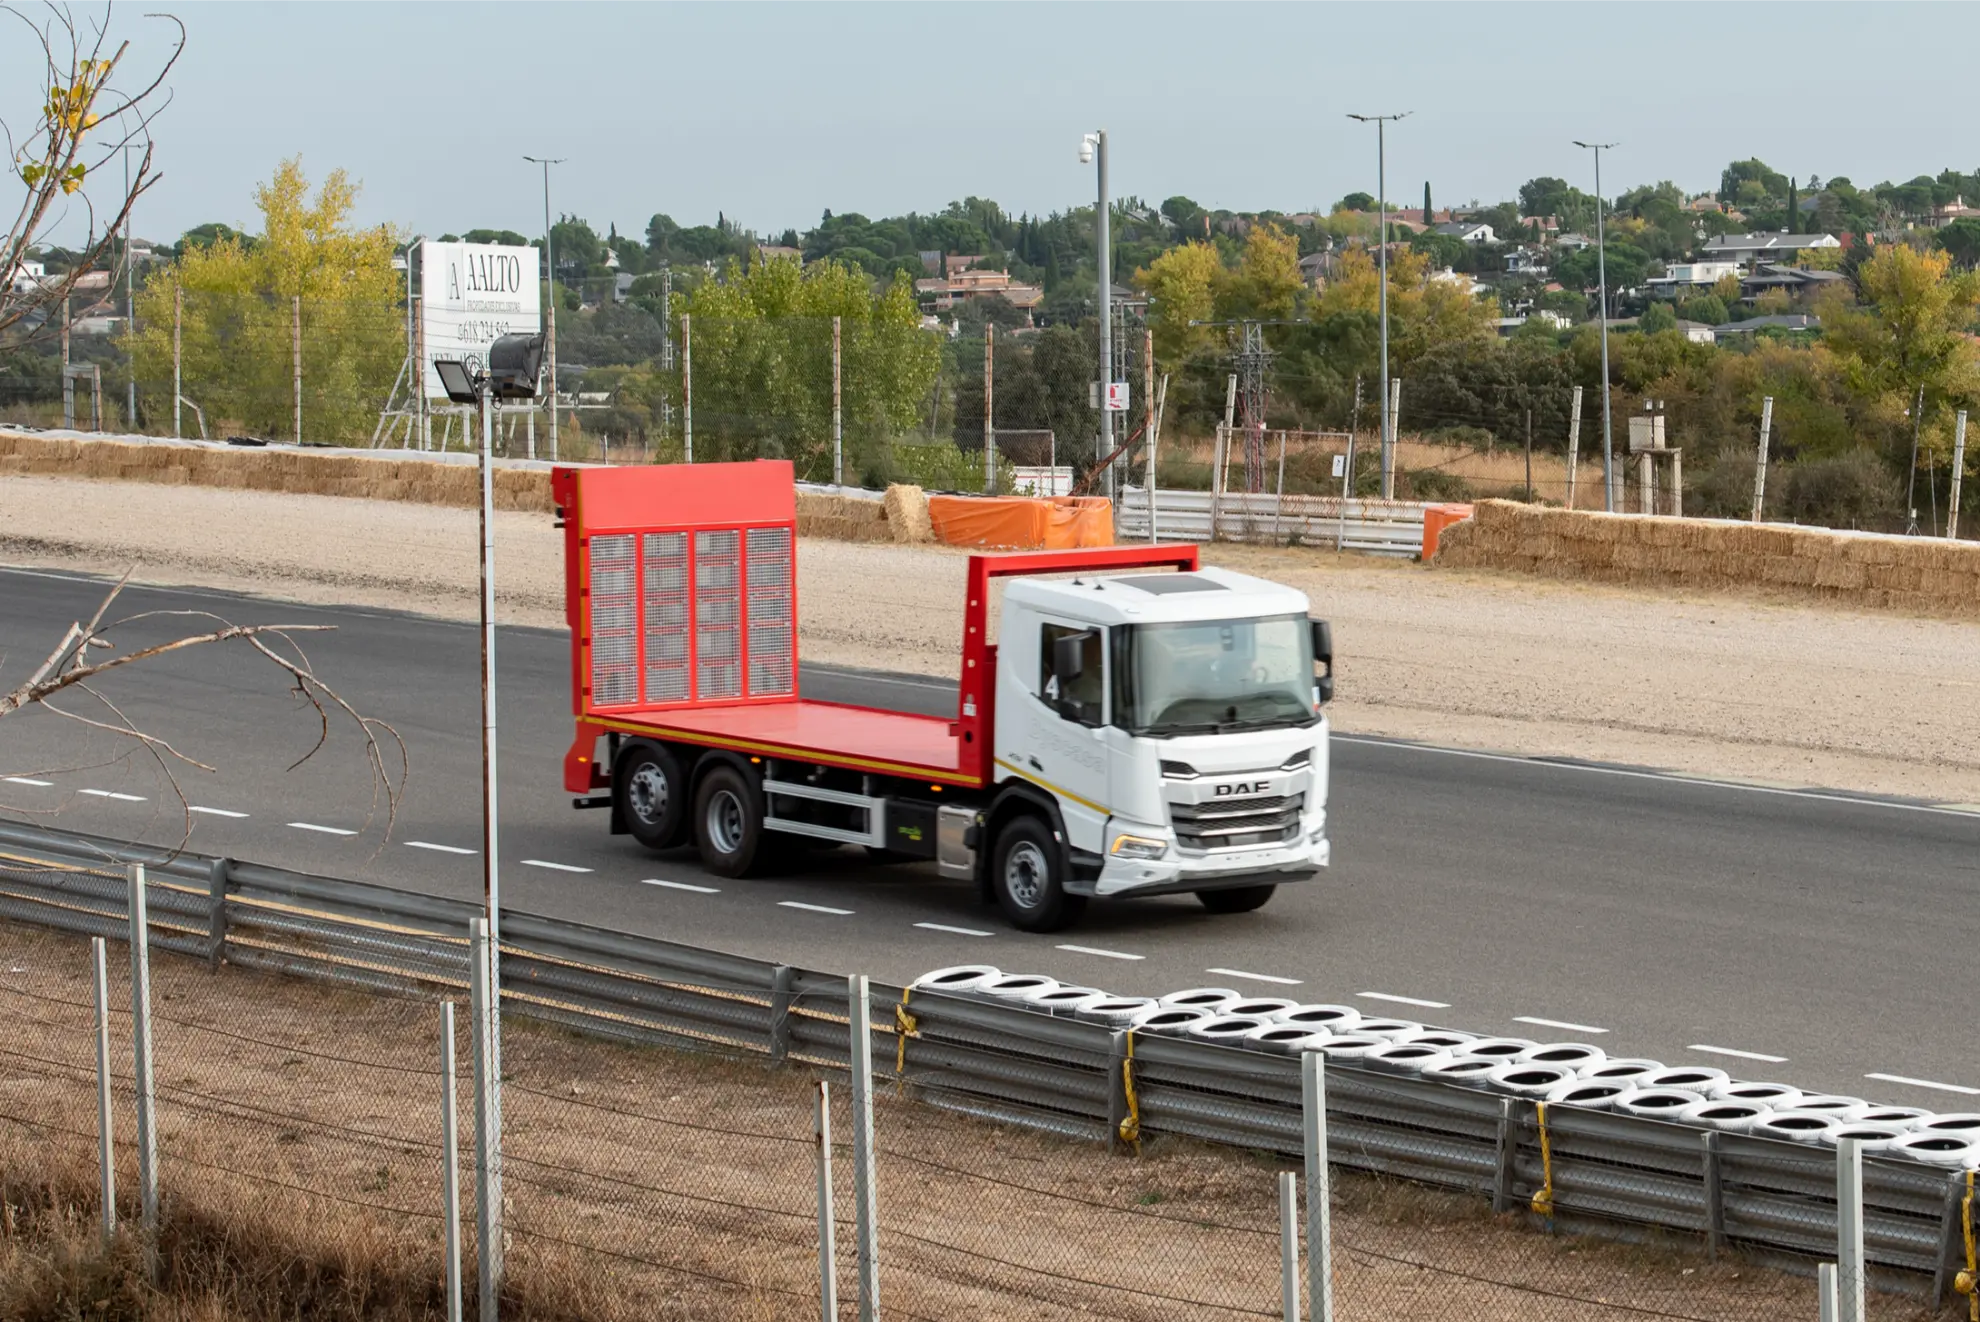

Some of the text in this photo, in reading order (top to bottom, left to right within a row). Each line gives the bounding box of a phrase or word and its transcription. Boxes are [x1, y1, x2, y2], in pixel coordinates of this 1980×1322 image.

[449, 262, 460, 299] A
[467, 253, 520, 293] AALTO
[464, 320, 478, 344] 618
[1045, 674, 1059, 700] 4
[1215, 781, 1270, 796] DAF
